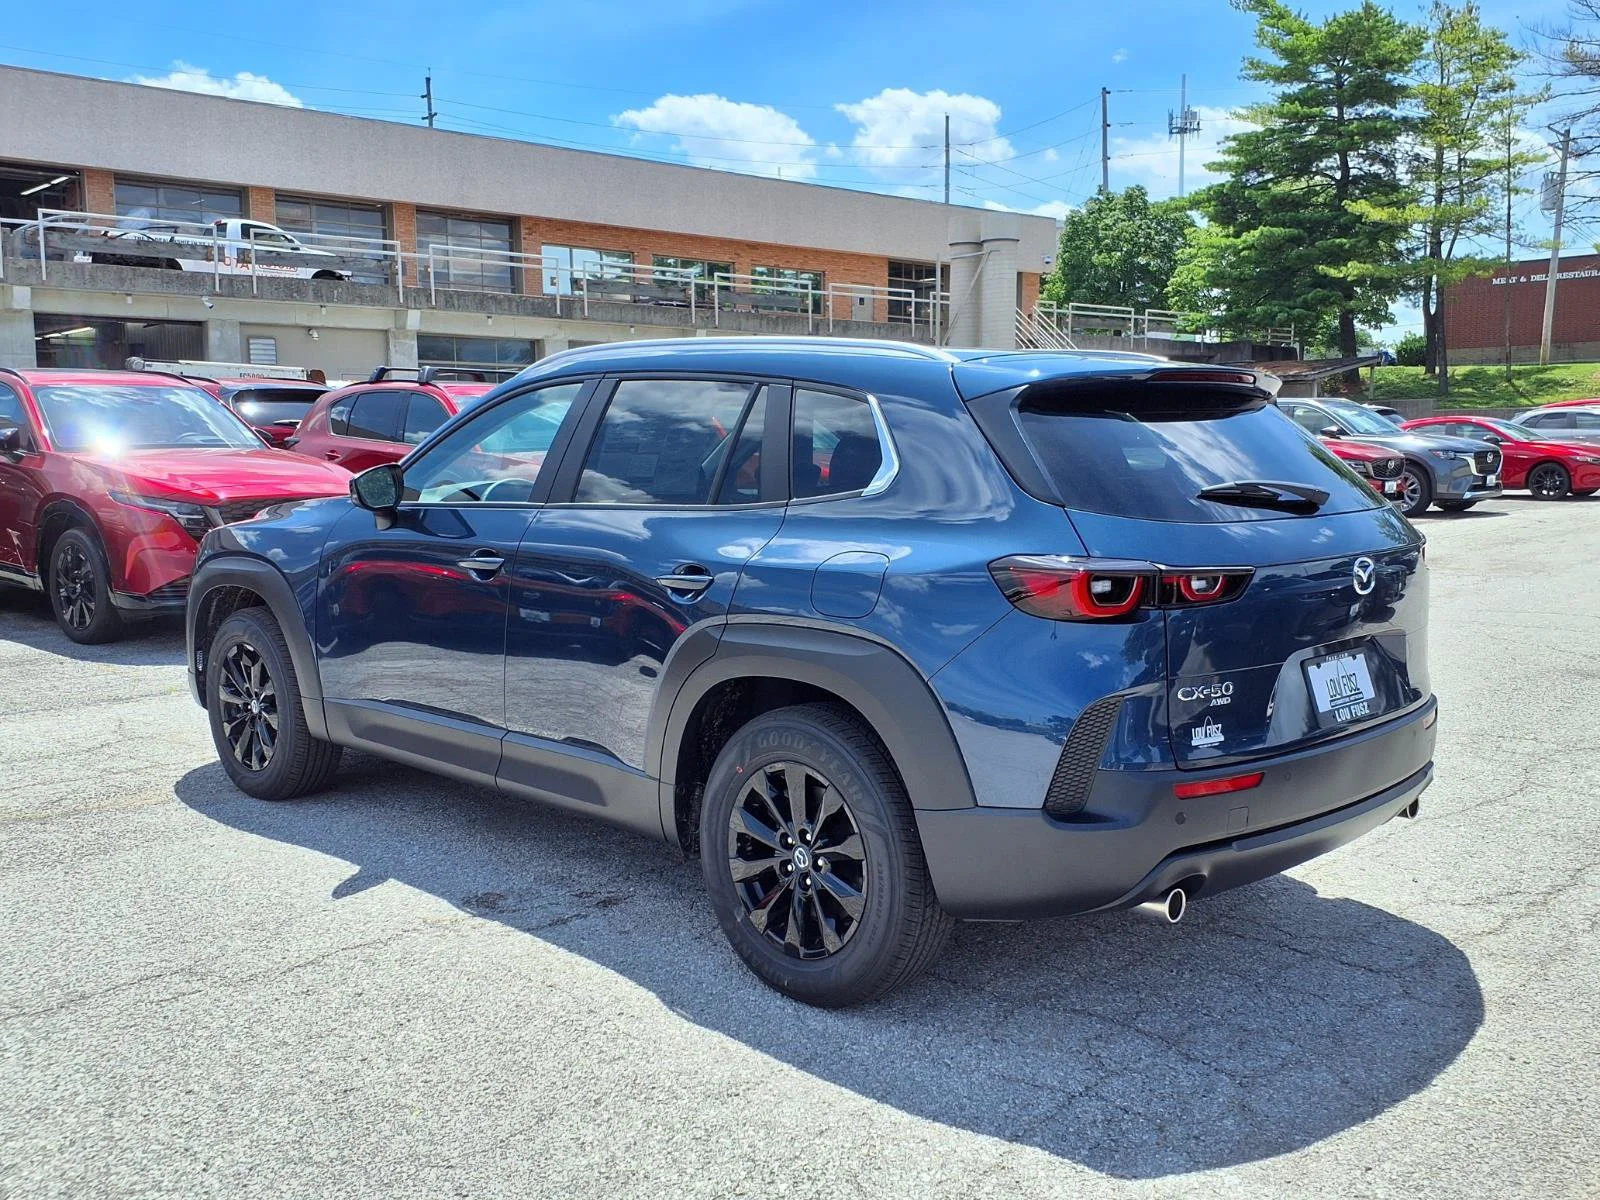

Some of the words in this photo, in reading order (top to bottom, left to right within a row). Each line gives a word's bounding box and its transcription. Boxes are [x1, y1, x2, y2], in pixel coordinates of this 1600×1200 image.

[1177, 681, 1234, 701] CX-50
[1326, 676, 1342, 698] LOU
[1341, 673, 1361, 695] FUSZ
[1209, 696, 1232, 706] AWD
[1335, 707, 1351, 722] LOU
[1350, 701, 1370, 717] FUSZ
[1192, 726, 1206, 740] LOU
[1206, 723, 1223, 738] FUSZ
